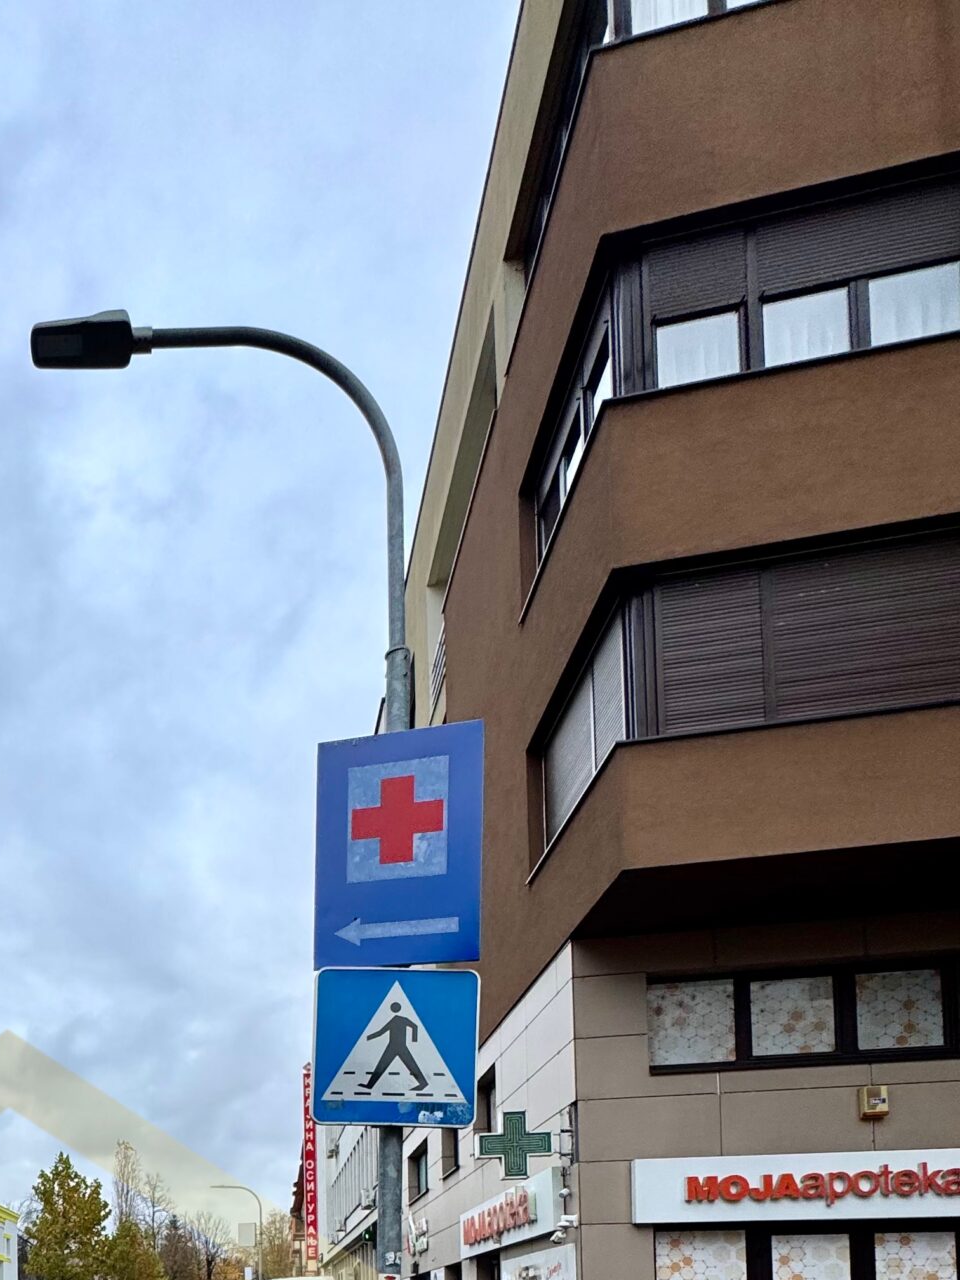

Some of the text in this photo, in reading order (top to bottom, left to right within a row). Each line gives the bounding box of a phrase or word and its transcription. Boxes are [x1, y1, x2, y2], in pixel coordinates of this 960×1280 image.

[304, 1076, 318, 1257] КРАИНА ОСИГУРАЊЕ
[684, 1162, 960, 1207] MOJAapoteka
